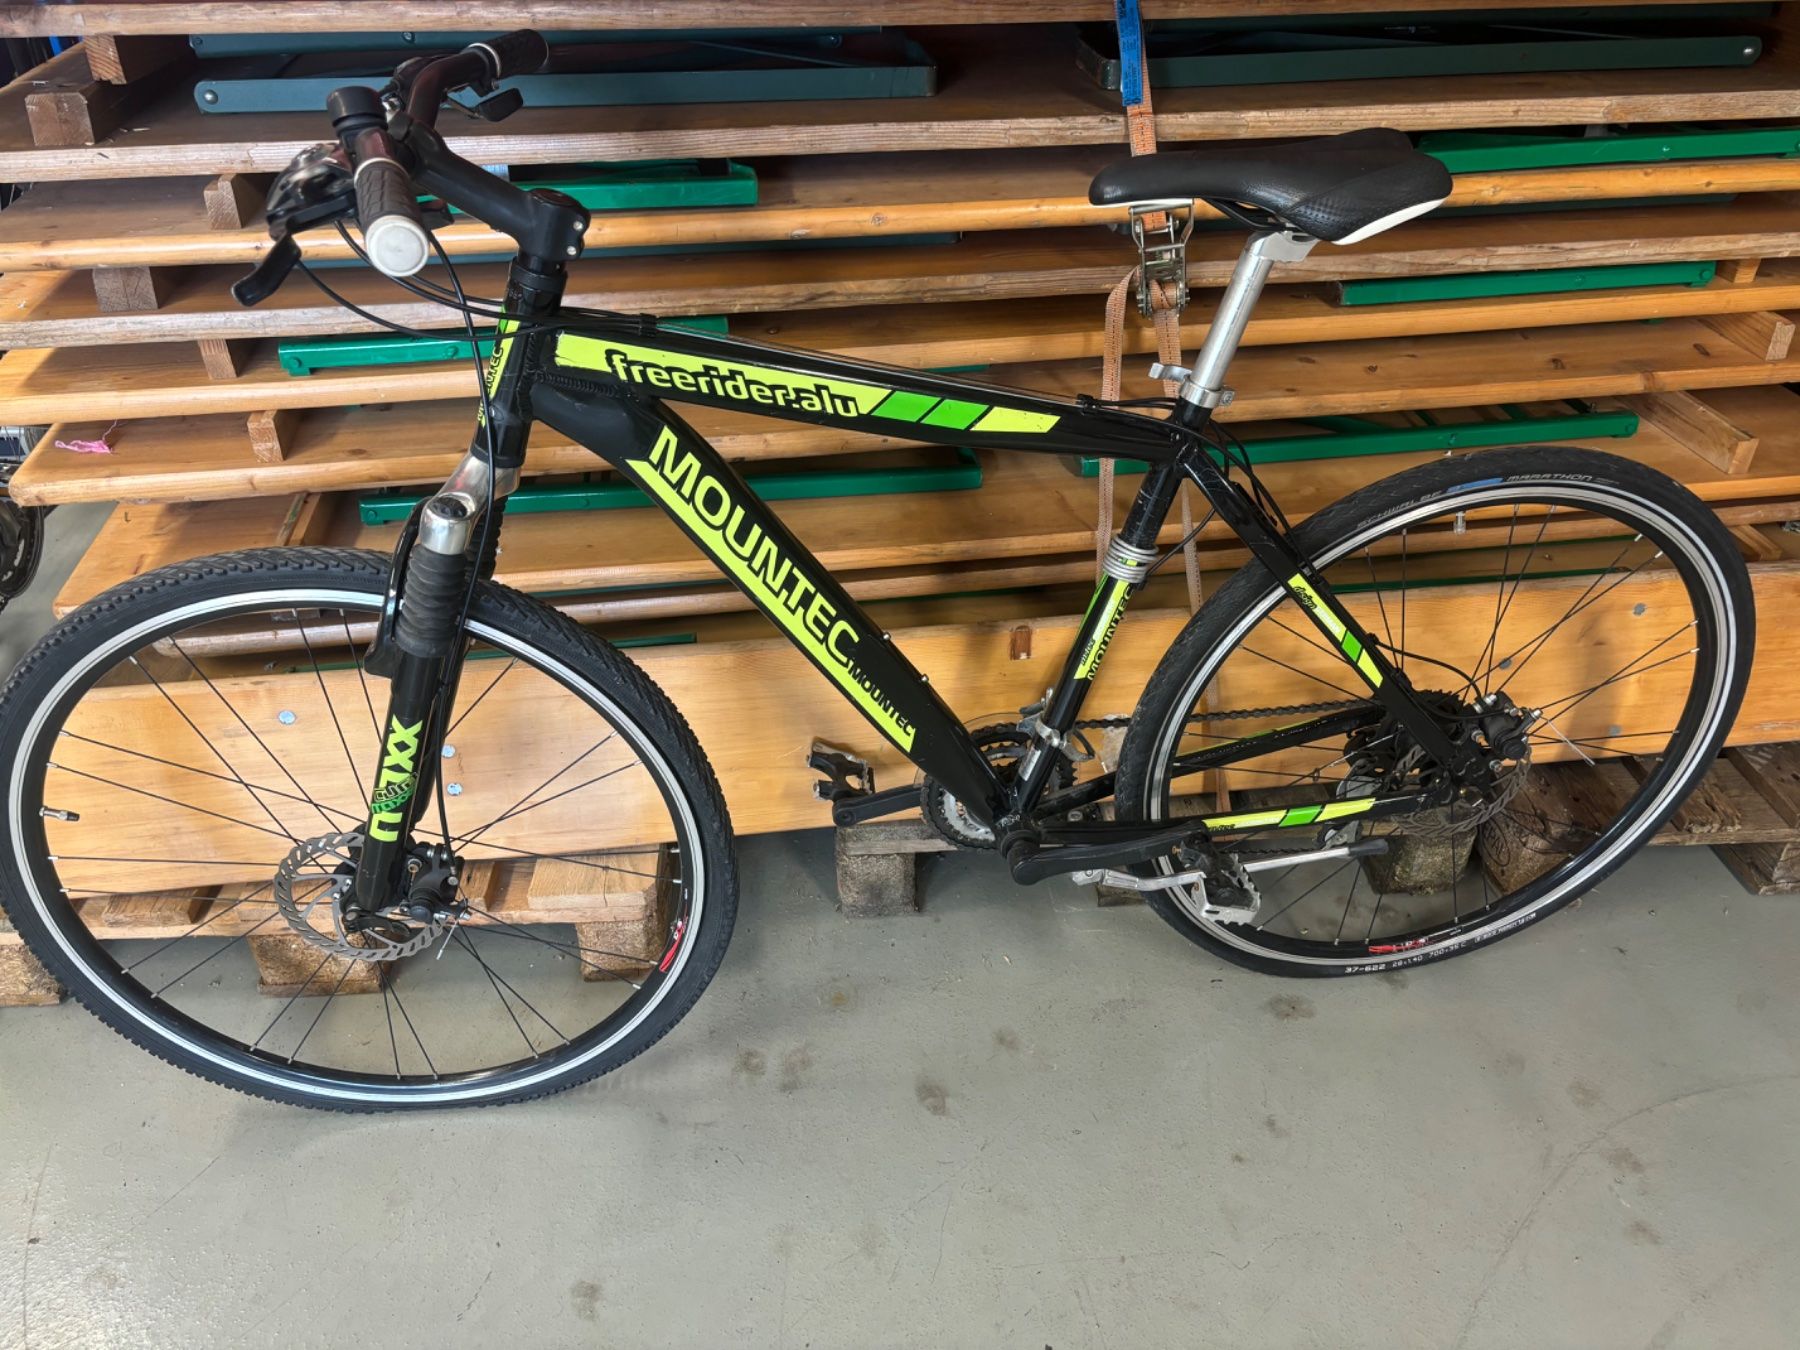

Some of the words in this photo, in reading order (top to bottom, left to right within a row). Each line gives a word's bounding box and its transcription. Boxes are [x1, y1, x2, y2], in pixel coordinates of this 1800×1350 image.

[1507, 473, 1593, 483] MARATHON
[648, 425, 860, 665] MOUNTEC
[1087, 585, 1135, 681] MOUNTEC
[848, 658, 915, 737] MOUNTEC
[1345, 963, 1386, 973] 37-622
